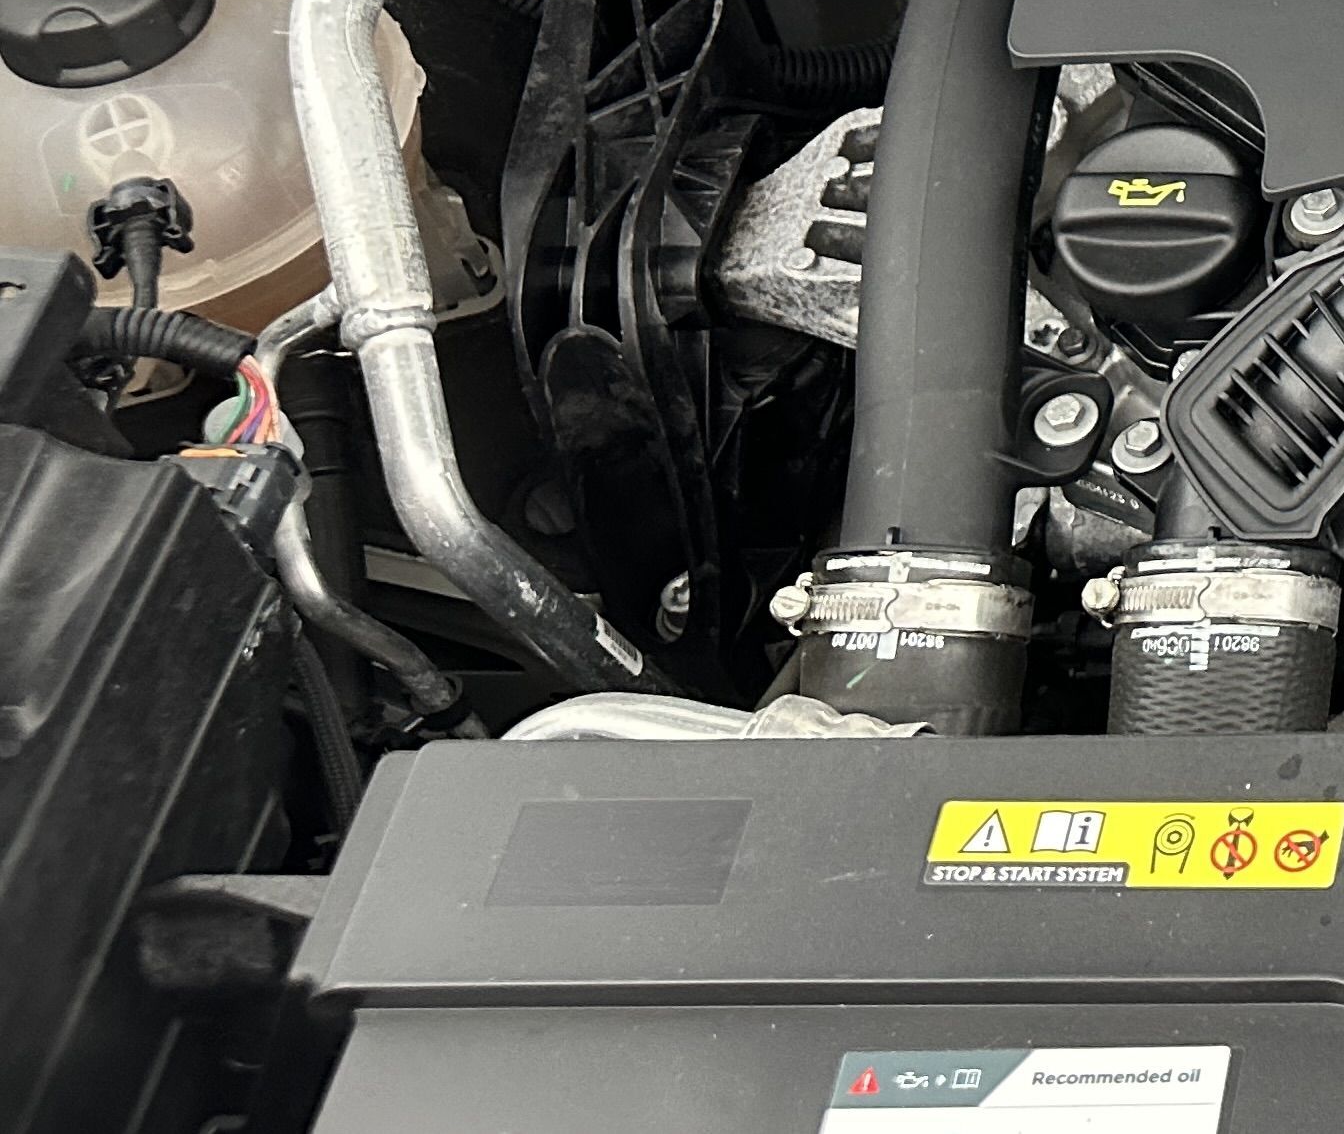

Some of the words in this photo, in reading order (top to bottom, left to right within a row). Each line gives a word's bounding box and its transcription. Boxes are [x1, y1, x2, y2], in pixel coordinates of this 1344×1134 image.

[931, 866, 982, 881] STOP
[982, 866, 997, 881] &
[998, 866, 1055, 881] START
[1056, 866, 1124, 882] SYSTEM
[1031, 1069, 1172, 1085] Recommended
[1177, 1069, 1202, 1083] oil
